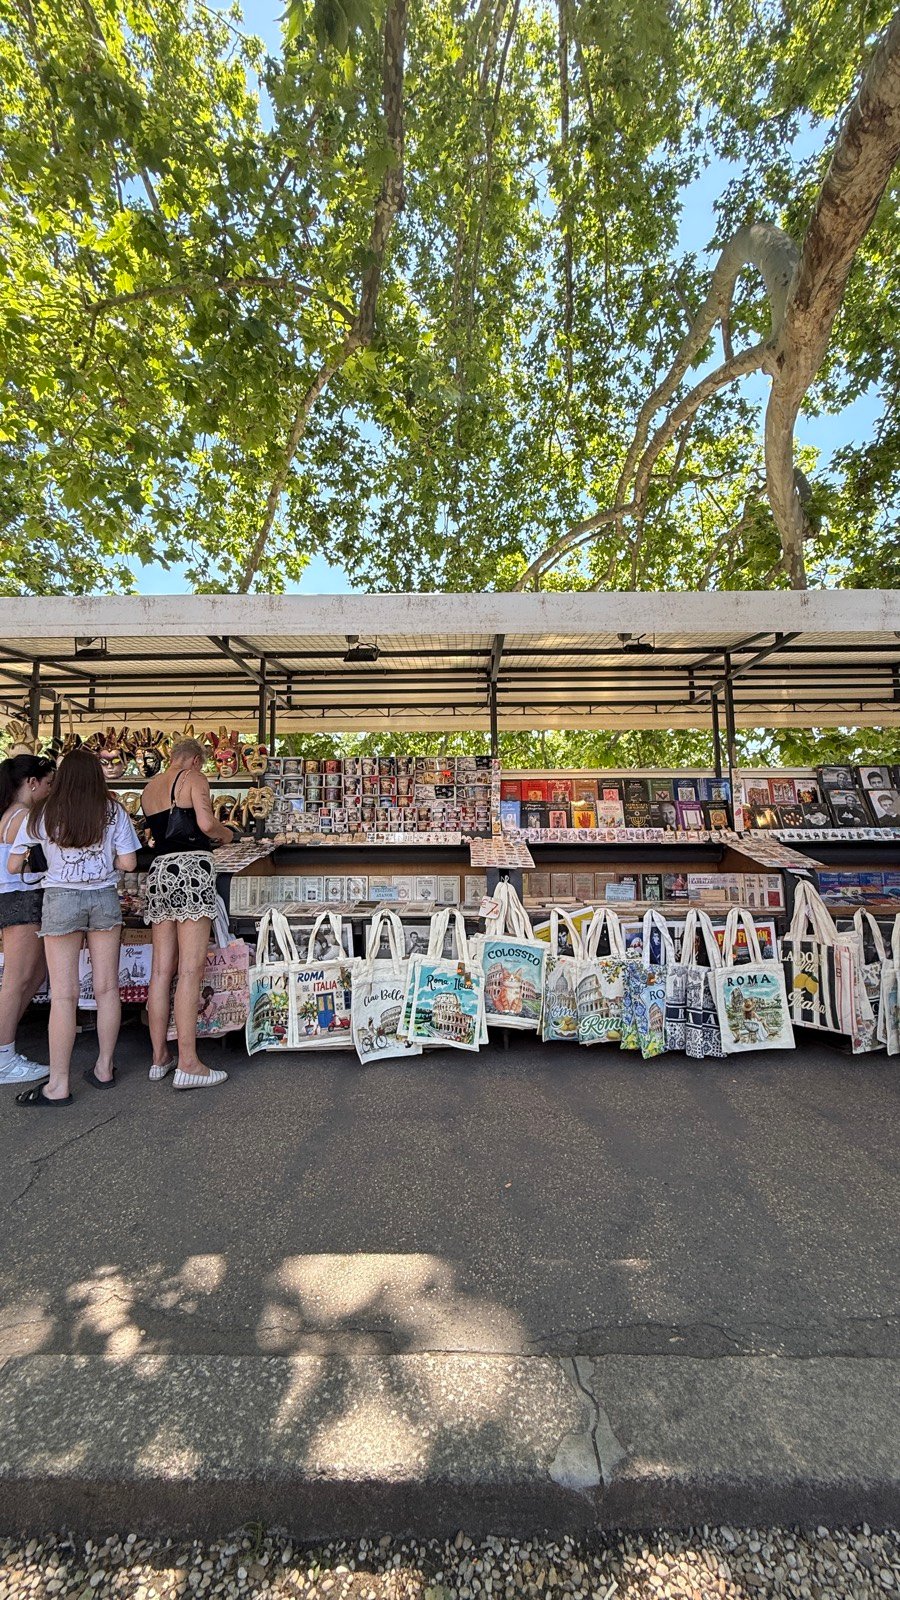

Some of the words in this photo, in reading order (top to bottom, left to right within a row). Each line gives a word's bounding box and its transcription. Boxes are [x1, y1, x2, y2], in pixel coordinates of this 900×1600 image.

[206, 955, 227, 966] MA
[487, 948, 540, 966] COLOSSEO
[297, 970, 324, 983] ROMA
[727, 974, 771, 986] ROMA
[313, 980, 337, 992] ITALIA
[426, 975, 448, 991] Roma
[364, 994, 379, 1007] Ciao
[381, 989, 404, 1001] Bella
[650, 989, 666, 1001] RO
